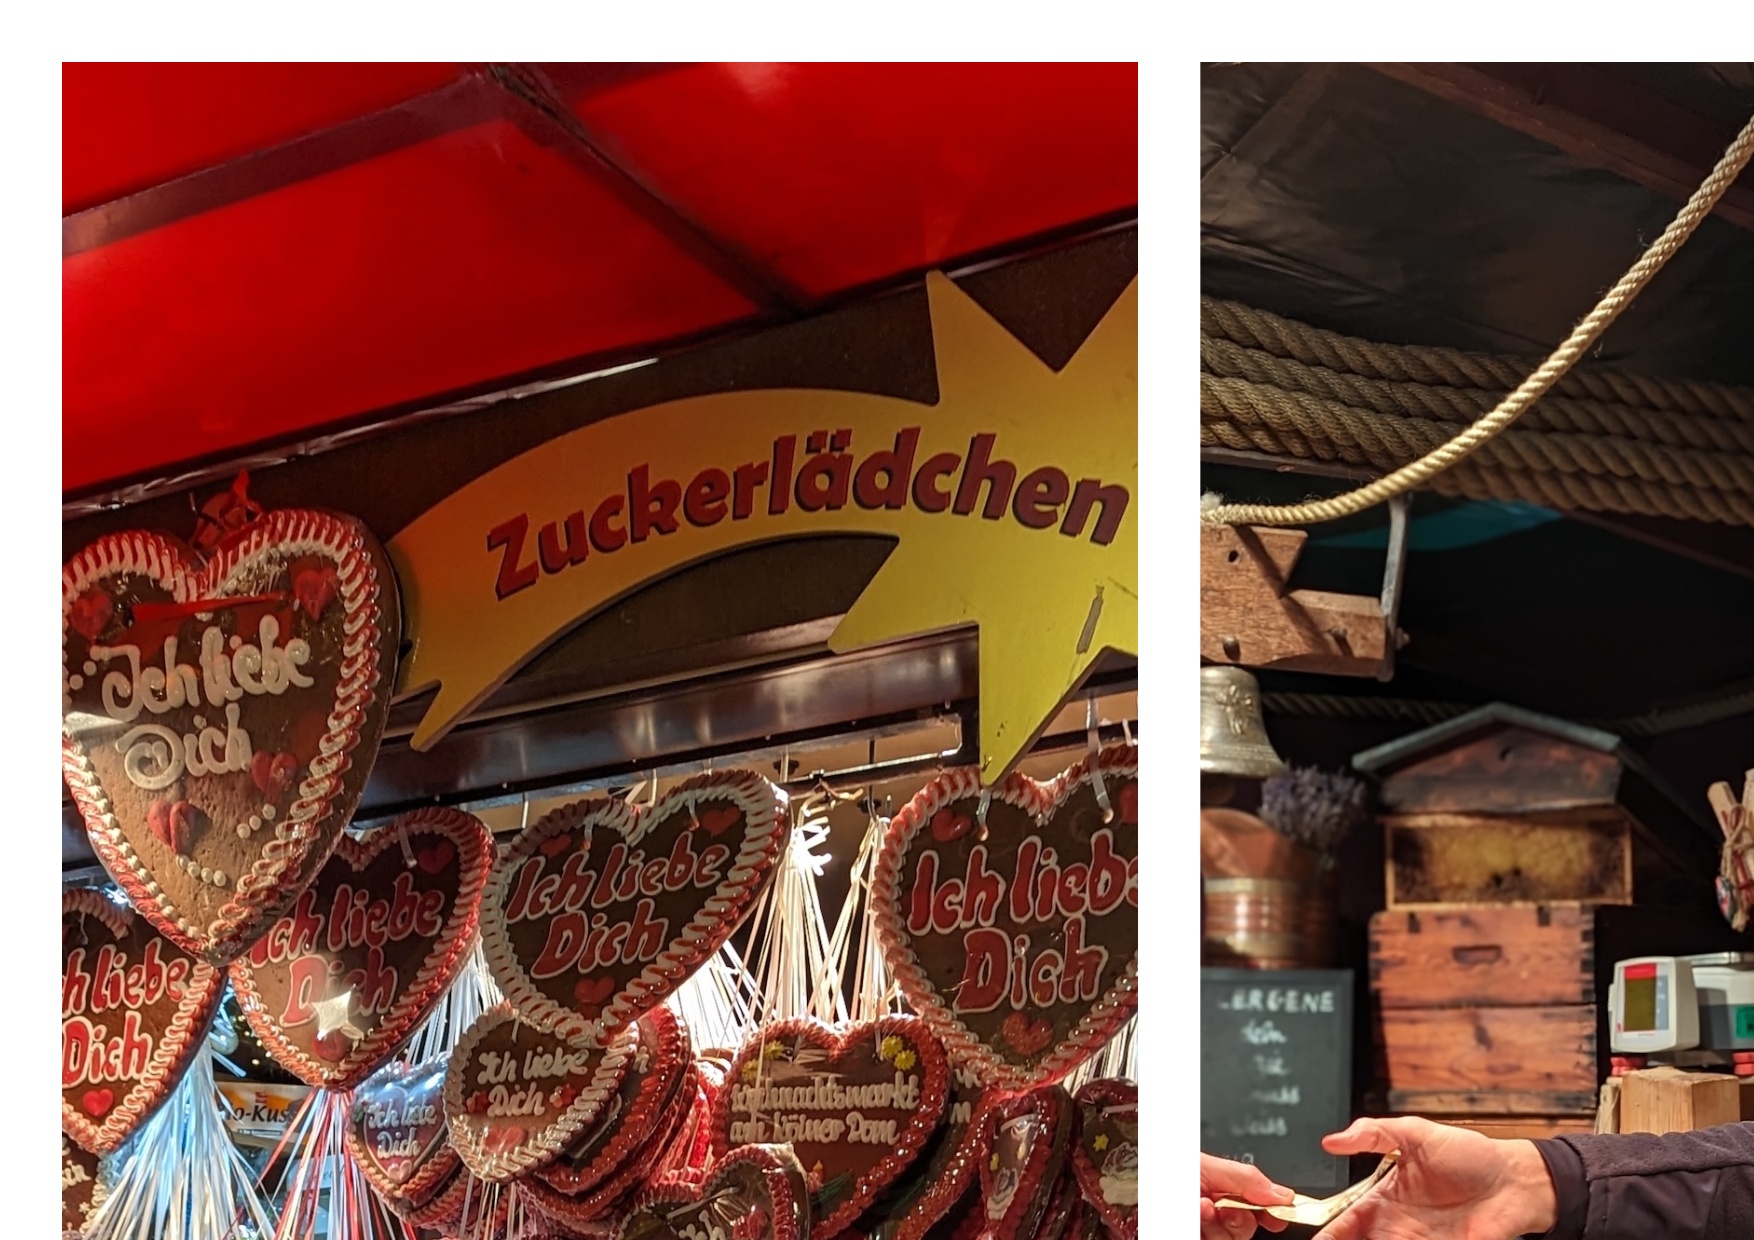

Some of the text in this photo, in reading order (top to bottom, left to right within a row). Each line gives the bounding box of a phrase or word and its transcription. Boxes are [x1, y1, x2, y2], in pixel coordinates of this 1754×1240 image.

[487, 427, 1130, 602] Zuckerlädchen
[91, 615, 315, 721] Ich liebe
[116, 702, 252, 790] Dich
[327, 872, 445, 951] liebe
[507, 830, 731, 922] Ich liebe
[909, 846, 1006, 936] Ich
[91, 937, 189, 1014] liebe
[530, 900, 668, 981] Dich
[953, 914, 1108, 1012] Dich
[279, 946, 399, 1027] Dich
[62, 1010, 153, 1088] Dich
[477, 1046, 591, 1085] Ich liebe
[367, 1099, 399, 1129] Ich
[486, 1081, 546, 1117] Dich
[773, 1111, 845, 1144] Kölner
[847, 1111, 901, 1145] Dom
[377, 1128, 421, 1158] Dich
